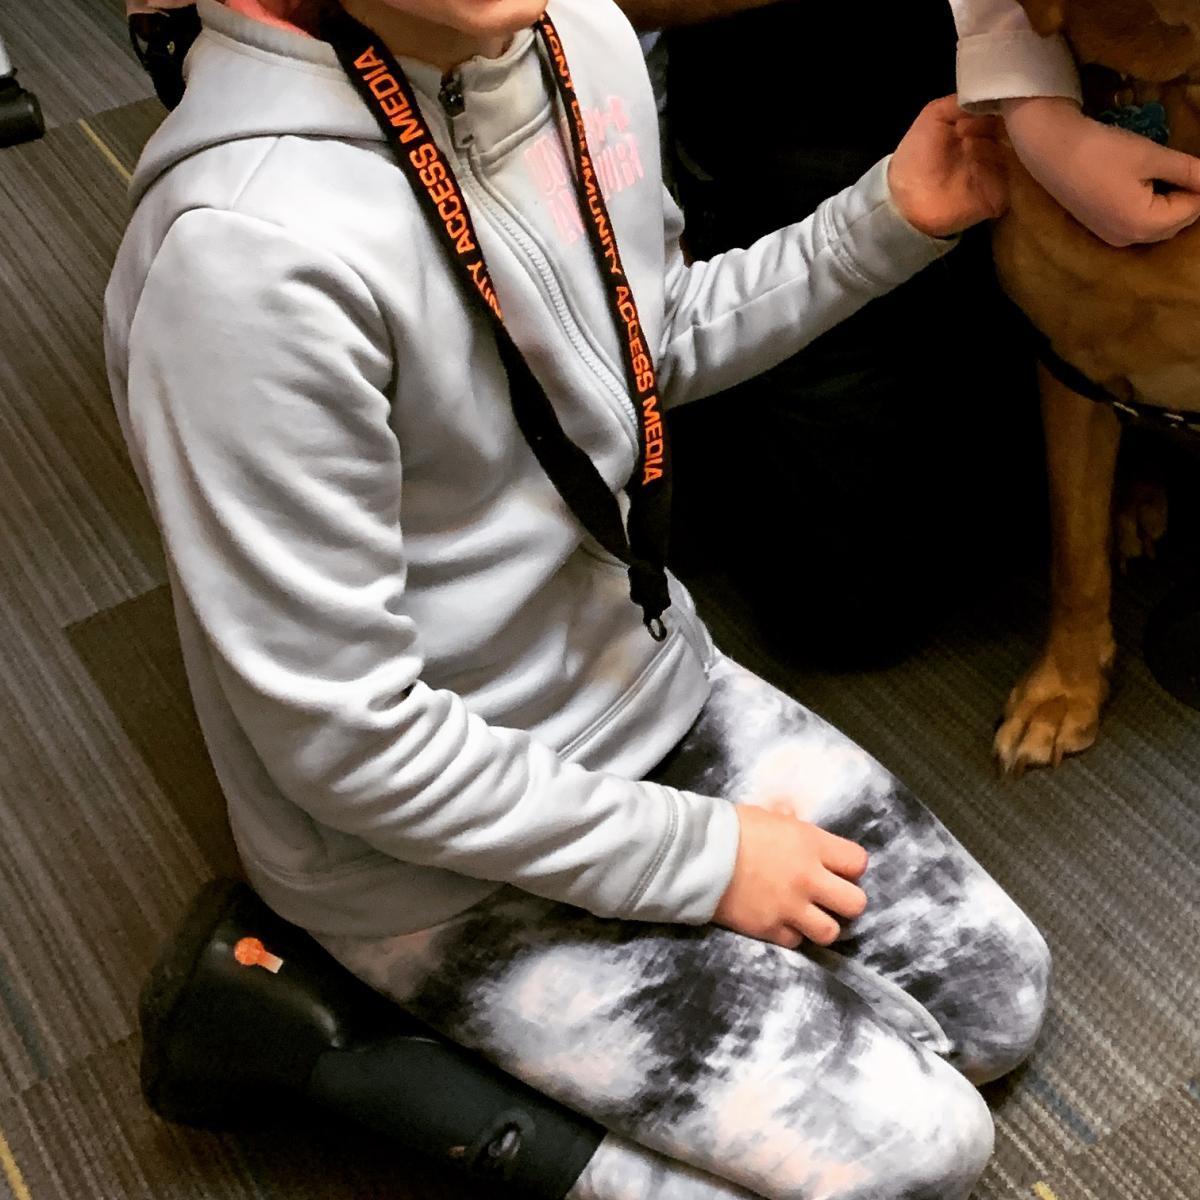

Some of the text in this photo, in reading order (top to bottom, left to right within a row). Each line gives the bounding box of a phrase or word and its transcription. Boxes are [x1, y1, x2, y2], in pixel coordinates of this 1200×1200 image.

[353, 45, 424, 144] MEDIA
[409, 142, 477, 255] ACCESS
[615, 285, 655, 394] ACCESS
[642, 396, 664, 487] MEDIA
